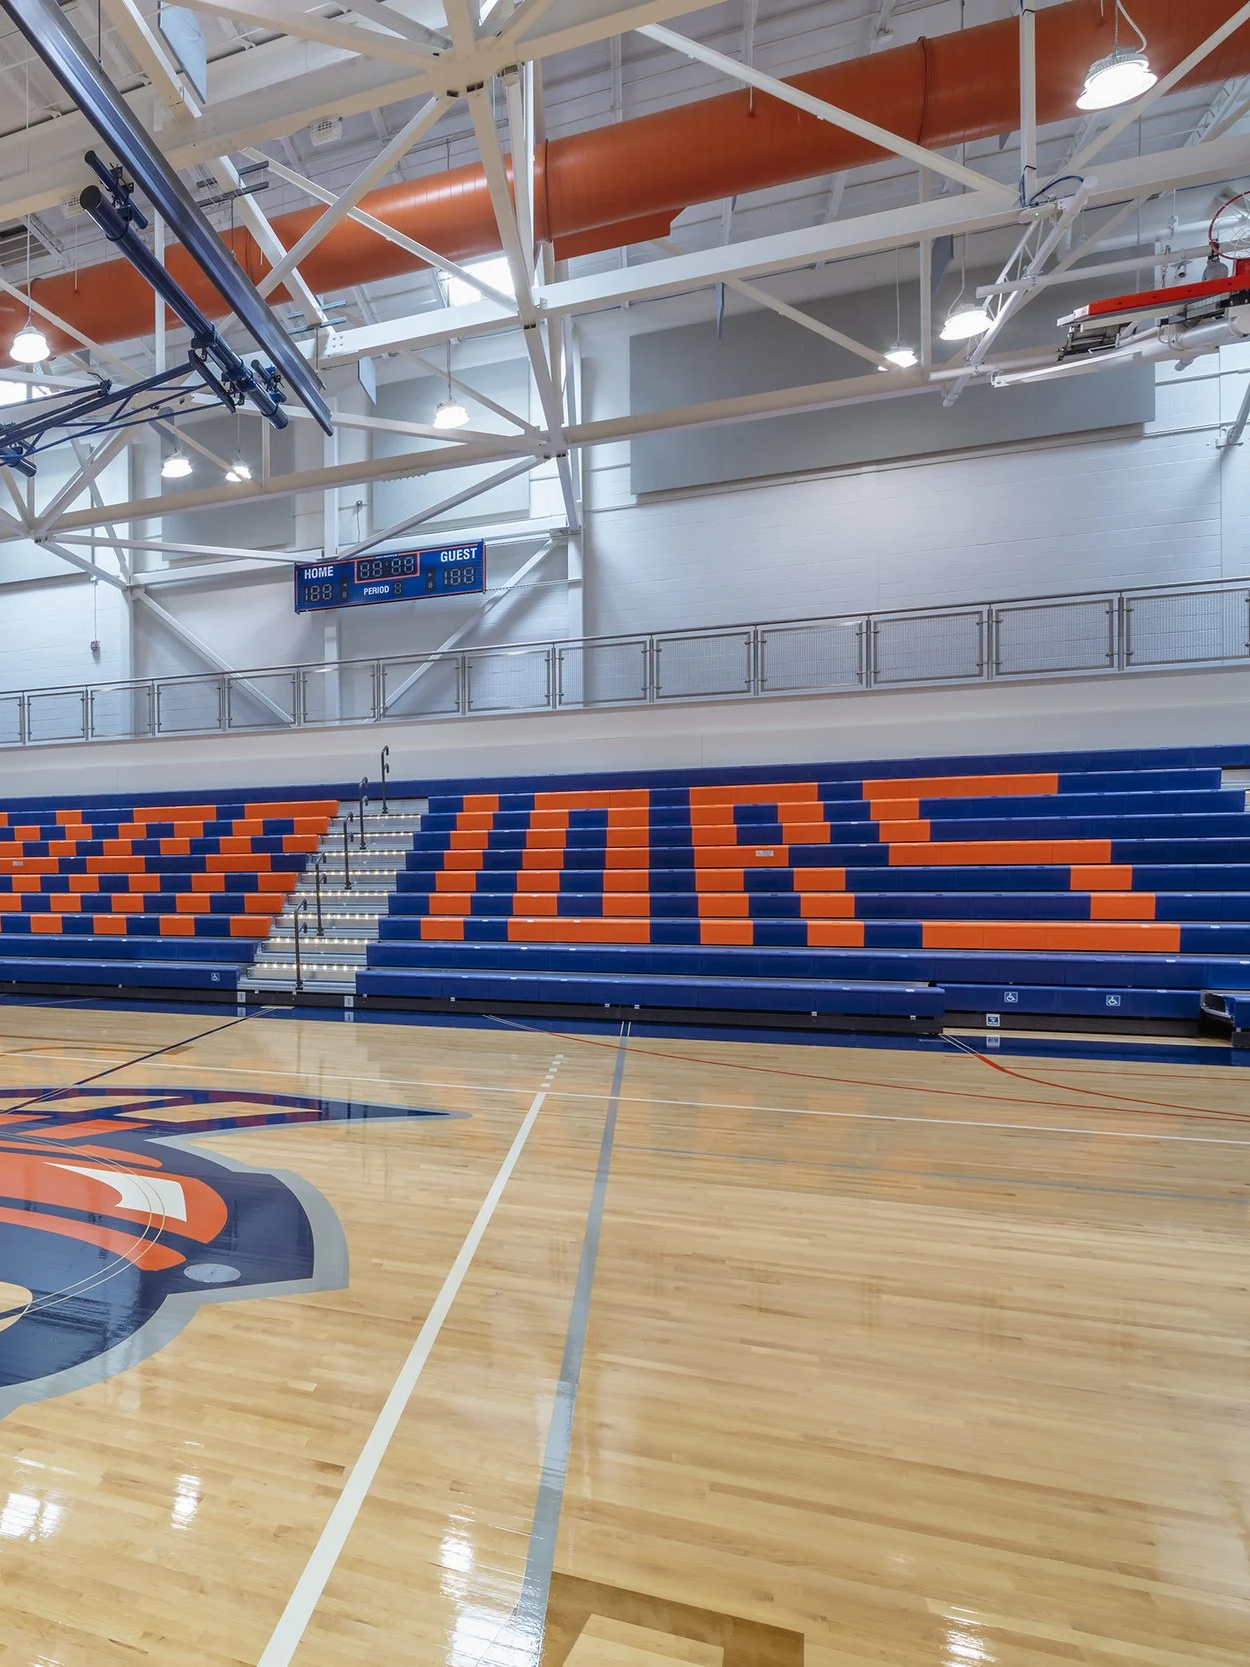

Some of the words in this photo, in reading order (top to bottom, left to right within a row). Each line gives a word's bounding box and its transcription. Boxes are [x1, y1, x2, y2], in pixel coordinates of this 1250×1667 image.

[440, 547, 478, 563] GUEST
[304, 566, 334, 579] HOME
[363, 585, 390, 596] PERIOD
